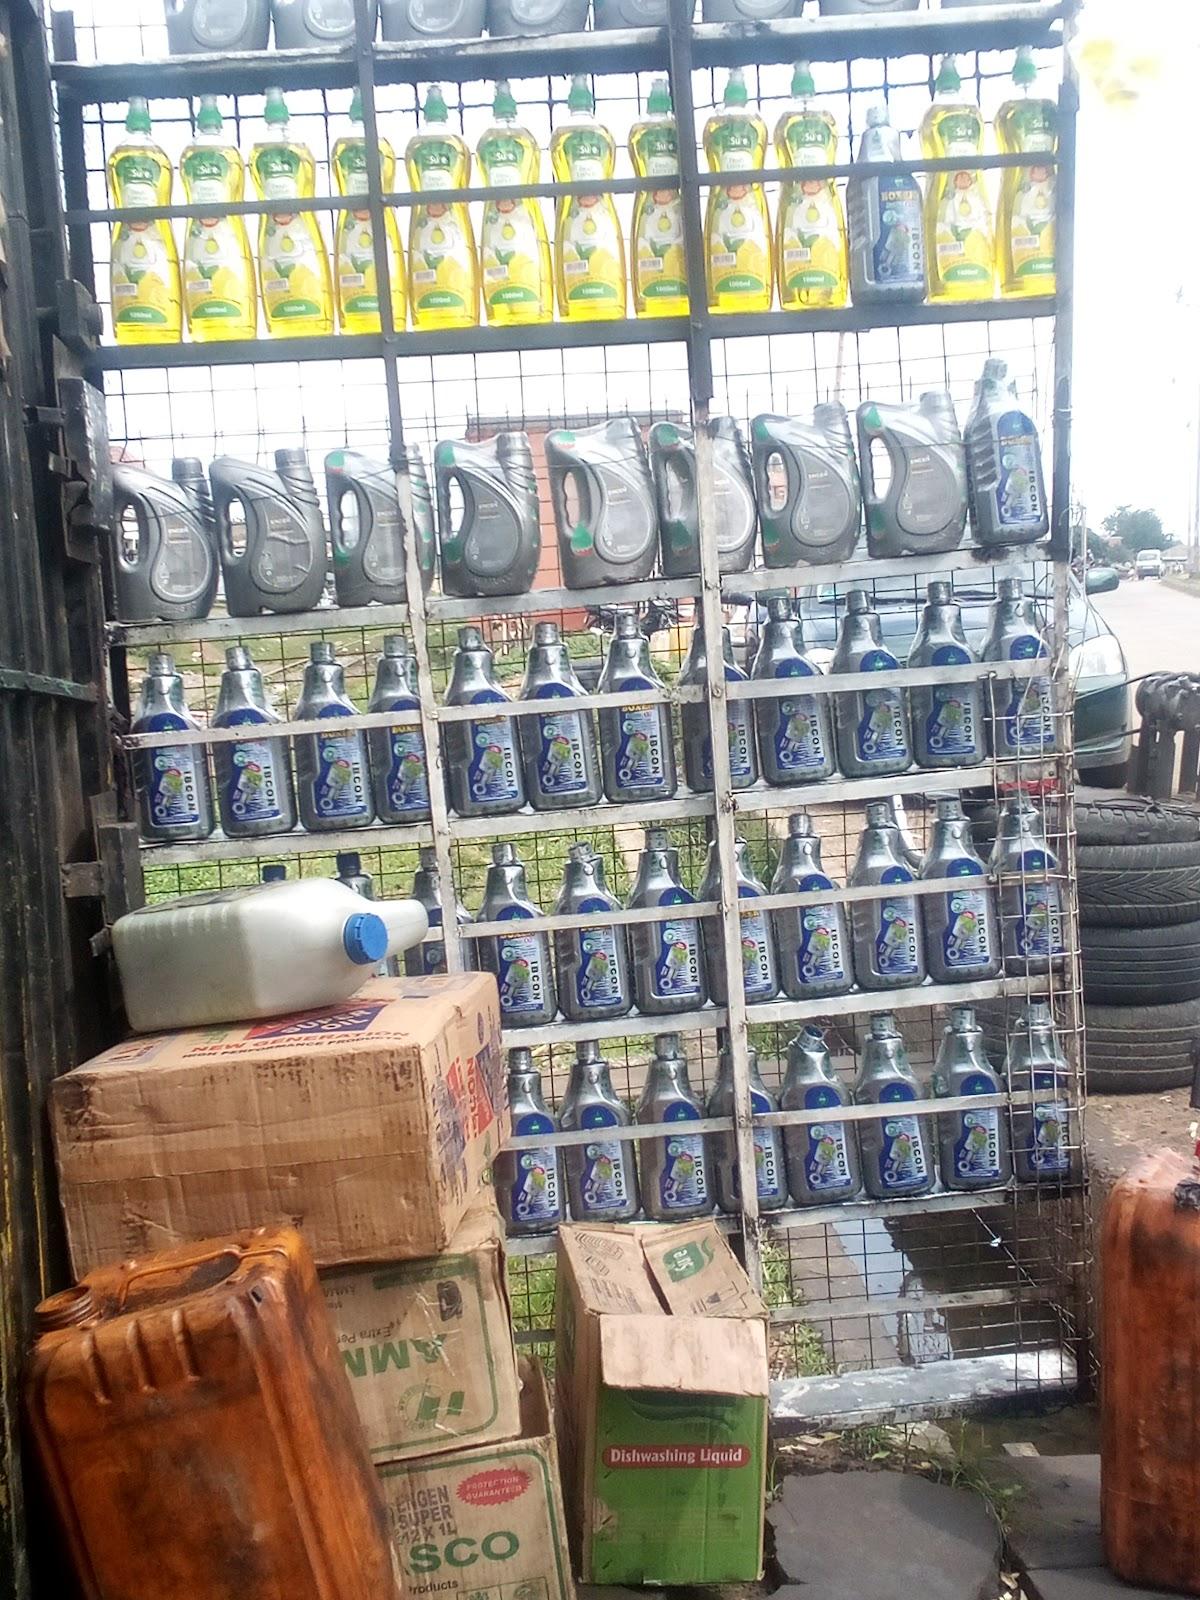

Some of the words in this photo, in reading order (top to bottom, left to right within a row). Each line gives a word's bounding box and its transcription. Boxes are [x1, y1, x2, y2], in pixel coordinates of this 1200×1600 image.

[1028, 470, 1038, 511] IBCON
[810, 713, 821, 755] IBCON
[962, 701, 972, 742] IBCON
[570, 738, 583, 778] IBCON
[649, 734, 660, 774] IBCON
[737, 723, 748, 764] IBCON
[263, 766, 276, 808] IBCON
[352, 762, 363, 802] IBCON
[503, 747, 515, 787] IBCON
[183, 770, 196, 812] IBCON
[830, 928, 840, 968] IBCON
[908, 922, 917, 962] IBCON
[977, 913, 987, 953] IBCON
[530, 961, 541, 1001] IBCON
[609, 954, 619, 994] IBCON
[688, 943, 699, 983] IBCON
[758, 941, 769, 981] IBCON
[280, 1008, 371, 1034] SUPER
[320, 1017, 369, 1031] OIL
[183, 1051, 221, 1059] HIGH
[222, 1042, 323, 1056] PERFORMANCE
[327, 1036, 402, 1048] PRODUCTS
[192, 1043, 248, 1053] NEW
[251, 1031, 410, 1047] GENERATION
[764, 1146, 775, 1186] IBCON
[836, 1138, 847, 1177] IBCON
[911, 1135, 923, 1174] IBCON
[988, 1128, 996, 1167] IBCON
[547, 1168, 557, 1208] IBCON
[612, 1158, 624, 1197] IBCON
[695, 1155, 705, 1195] IBCON
[359, 1326, 392, 1338] Extra
[610, 1448, 696, 1465] Dishwashing
[700, 1447, 742, 1464] Liquid
[397, 1485, 450, 1513] ENGEN
[465, 1485, 522, 1500] GUARANTEED
[466, 1476, 519, 1490] PROTECTION
[399, 1504, 453, 1530] SUPER
[423, 1526, 435, 1542] X
[438, 1521, 458, 1536] 1L
